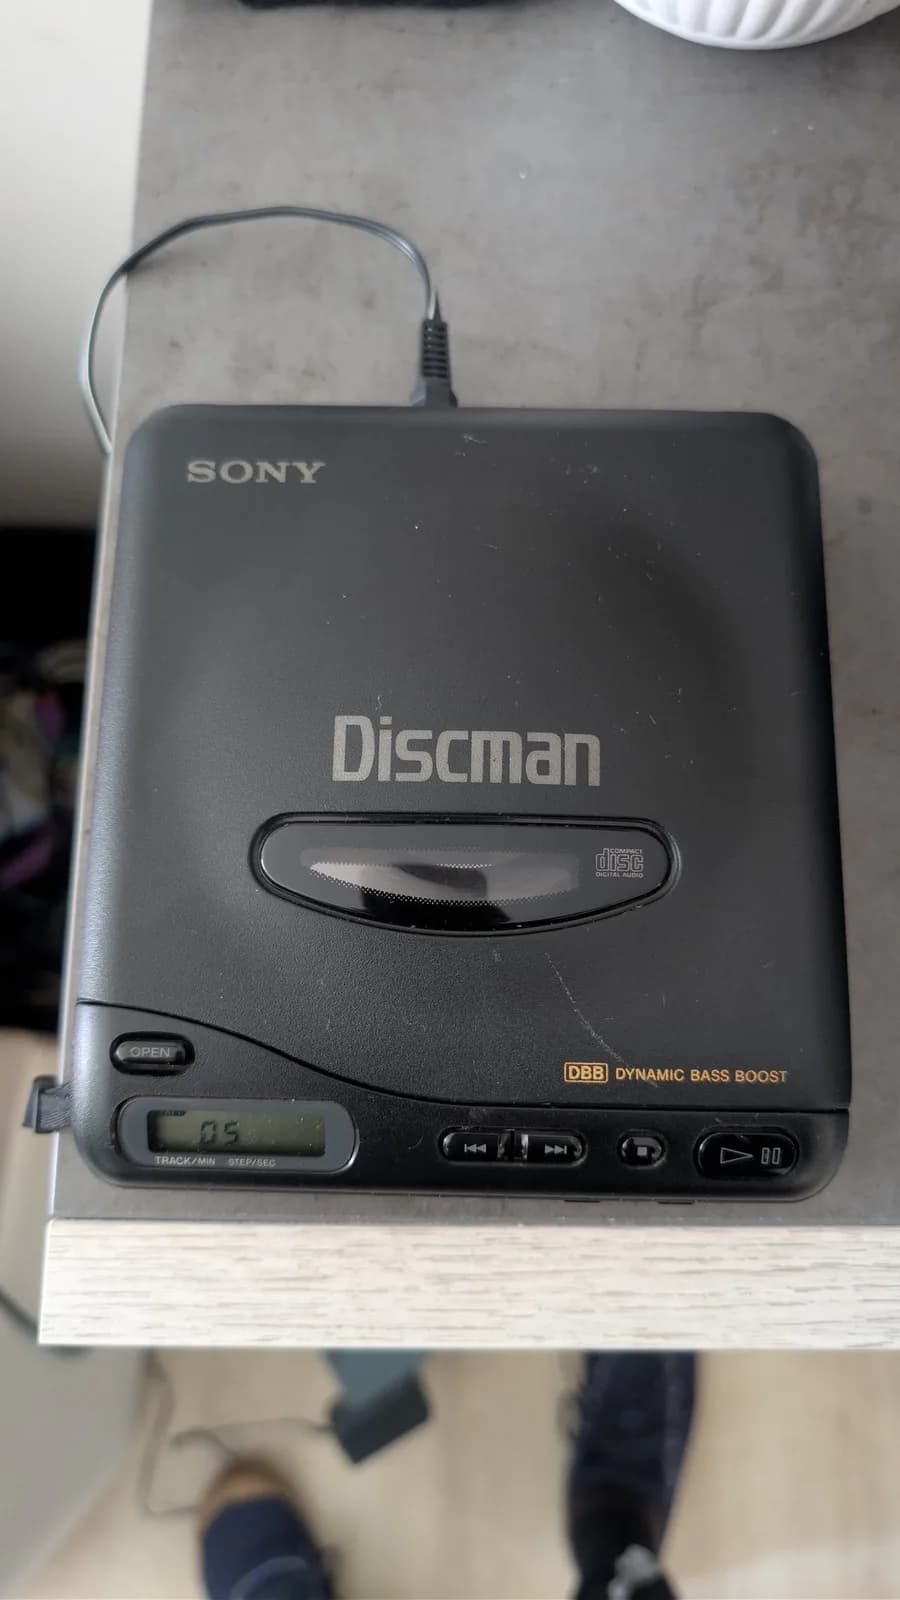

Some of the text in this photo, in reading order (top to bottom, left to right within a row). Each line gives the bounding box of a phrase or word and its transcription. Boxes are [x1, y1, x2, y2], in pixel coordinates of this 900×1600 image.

[187, 460, 326, 484] SONY
[332, 715, 600, 787] Discman
[595, 848, 644, 872] disc
[130, 1046, 170, 1058] OPEN
[567, 1065, 788, 1083] DBB DYNAMIC BASS BOOST
[200, 1120, 240, 1146] 05
[154, 1155, 277, 1168] TRACK/MIN STEP/SEC
